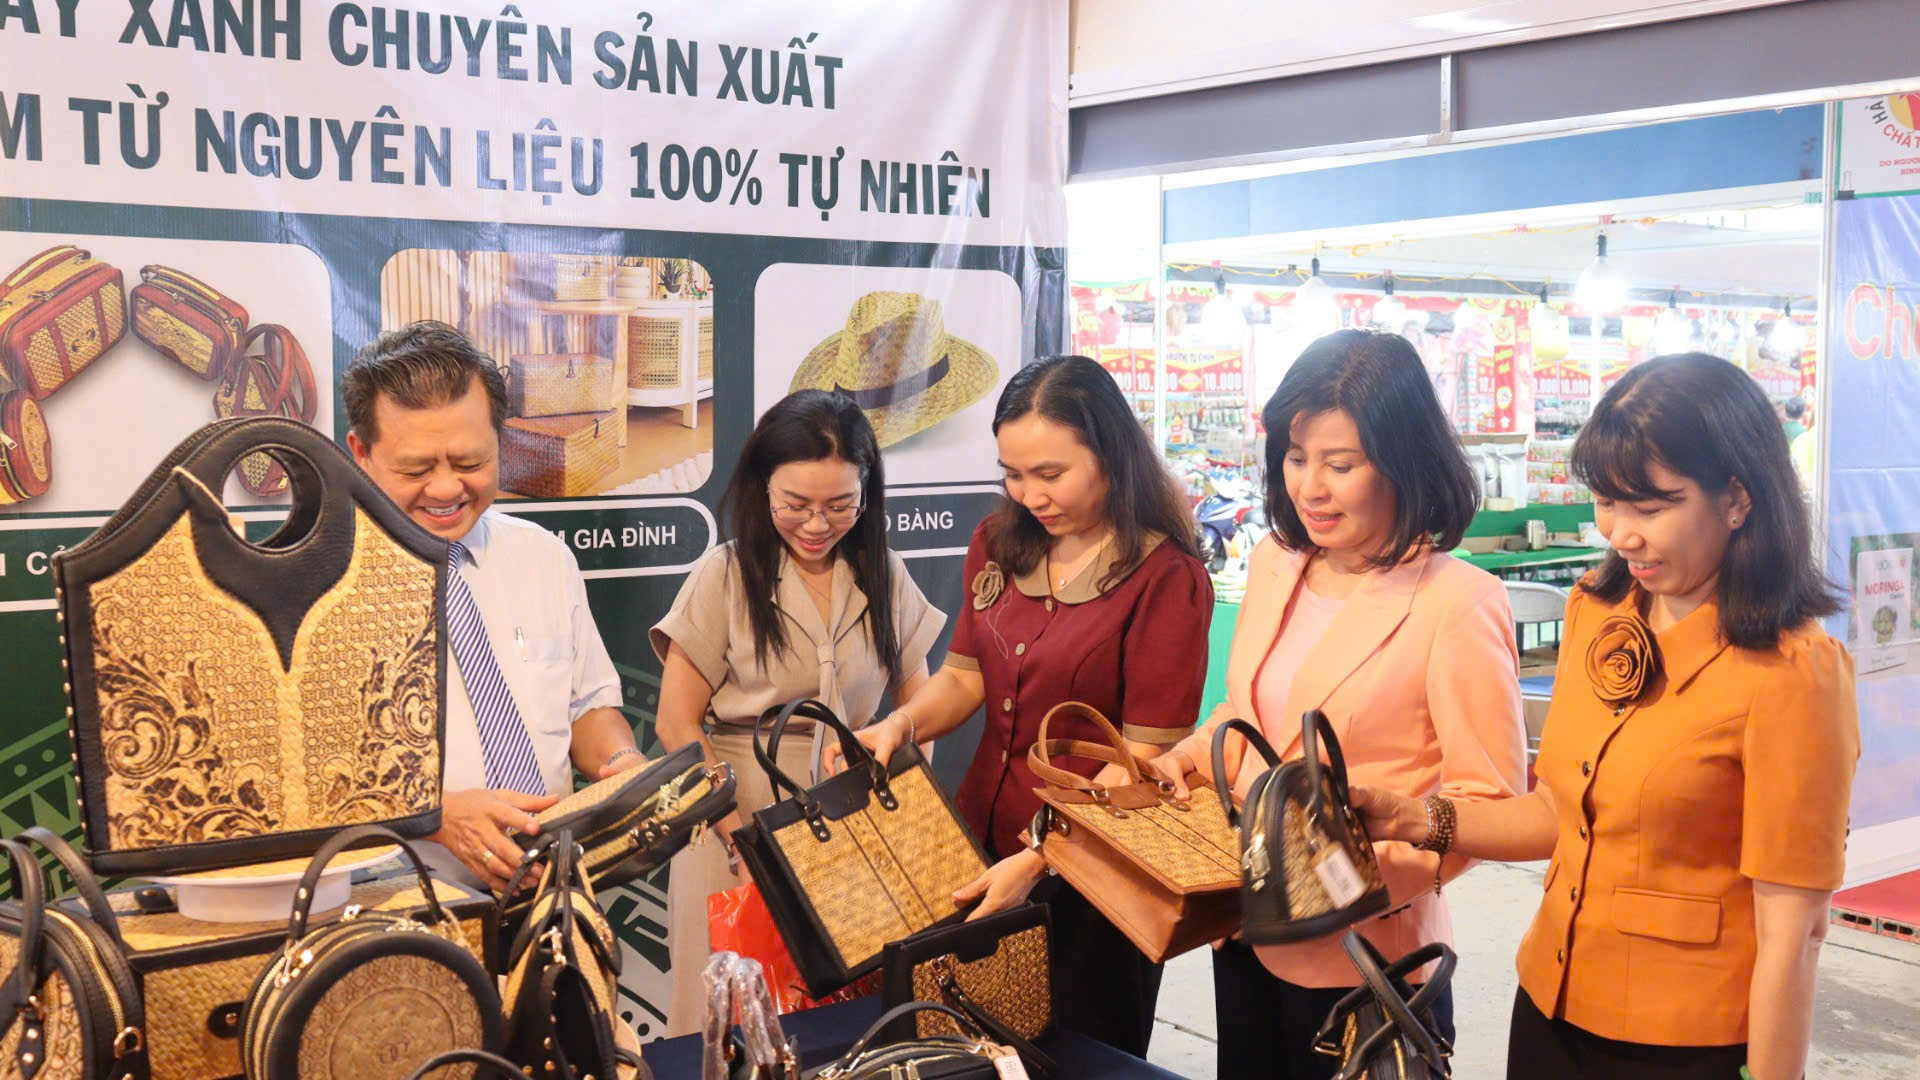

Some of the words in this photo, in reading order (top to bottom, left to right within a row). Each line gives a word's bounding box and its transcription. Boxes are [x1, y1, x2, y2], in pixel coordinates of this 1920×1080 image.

[119, 0, 302, 61] XANH
[328, 3, 573, 85] CHUYÊN
[592, 12, 699, 97] SẢN
[717, 32, 844, 110] XUẤT
[68, 83, 169, 169] TỪ
[195, 105, 452, 187] NGUYÊN
[475, 117, 604, 206] LIỆU
[630, 142, 763, 207] 100%
[779, 146, 846, 221] TỰ
[860, 150, 991, 218] NHIÊN
[1847, 282, 1920, 360] Ch
[574, 528, 616, 549] GIA
[621, 521, 676, 547] ĐÌNH
[897, 508, 954, 531] BÀNG
